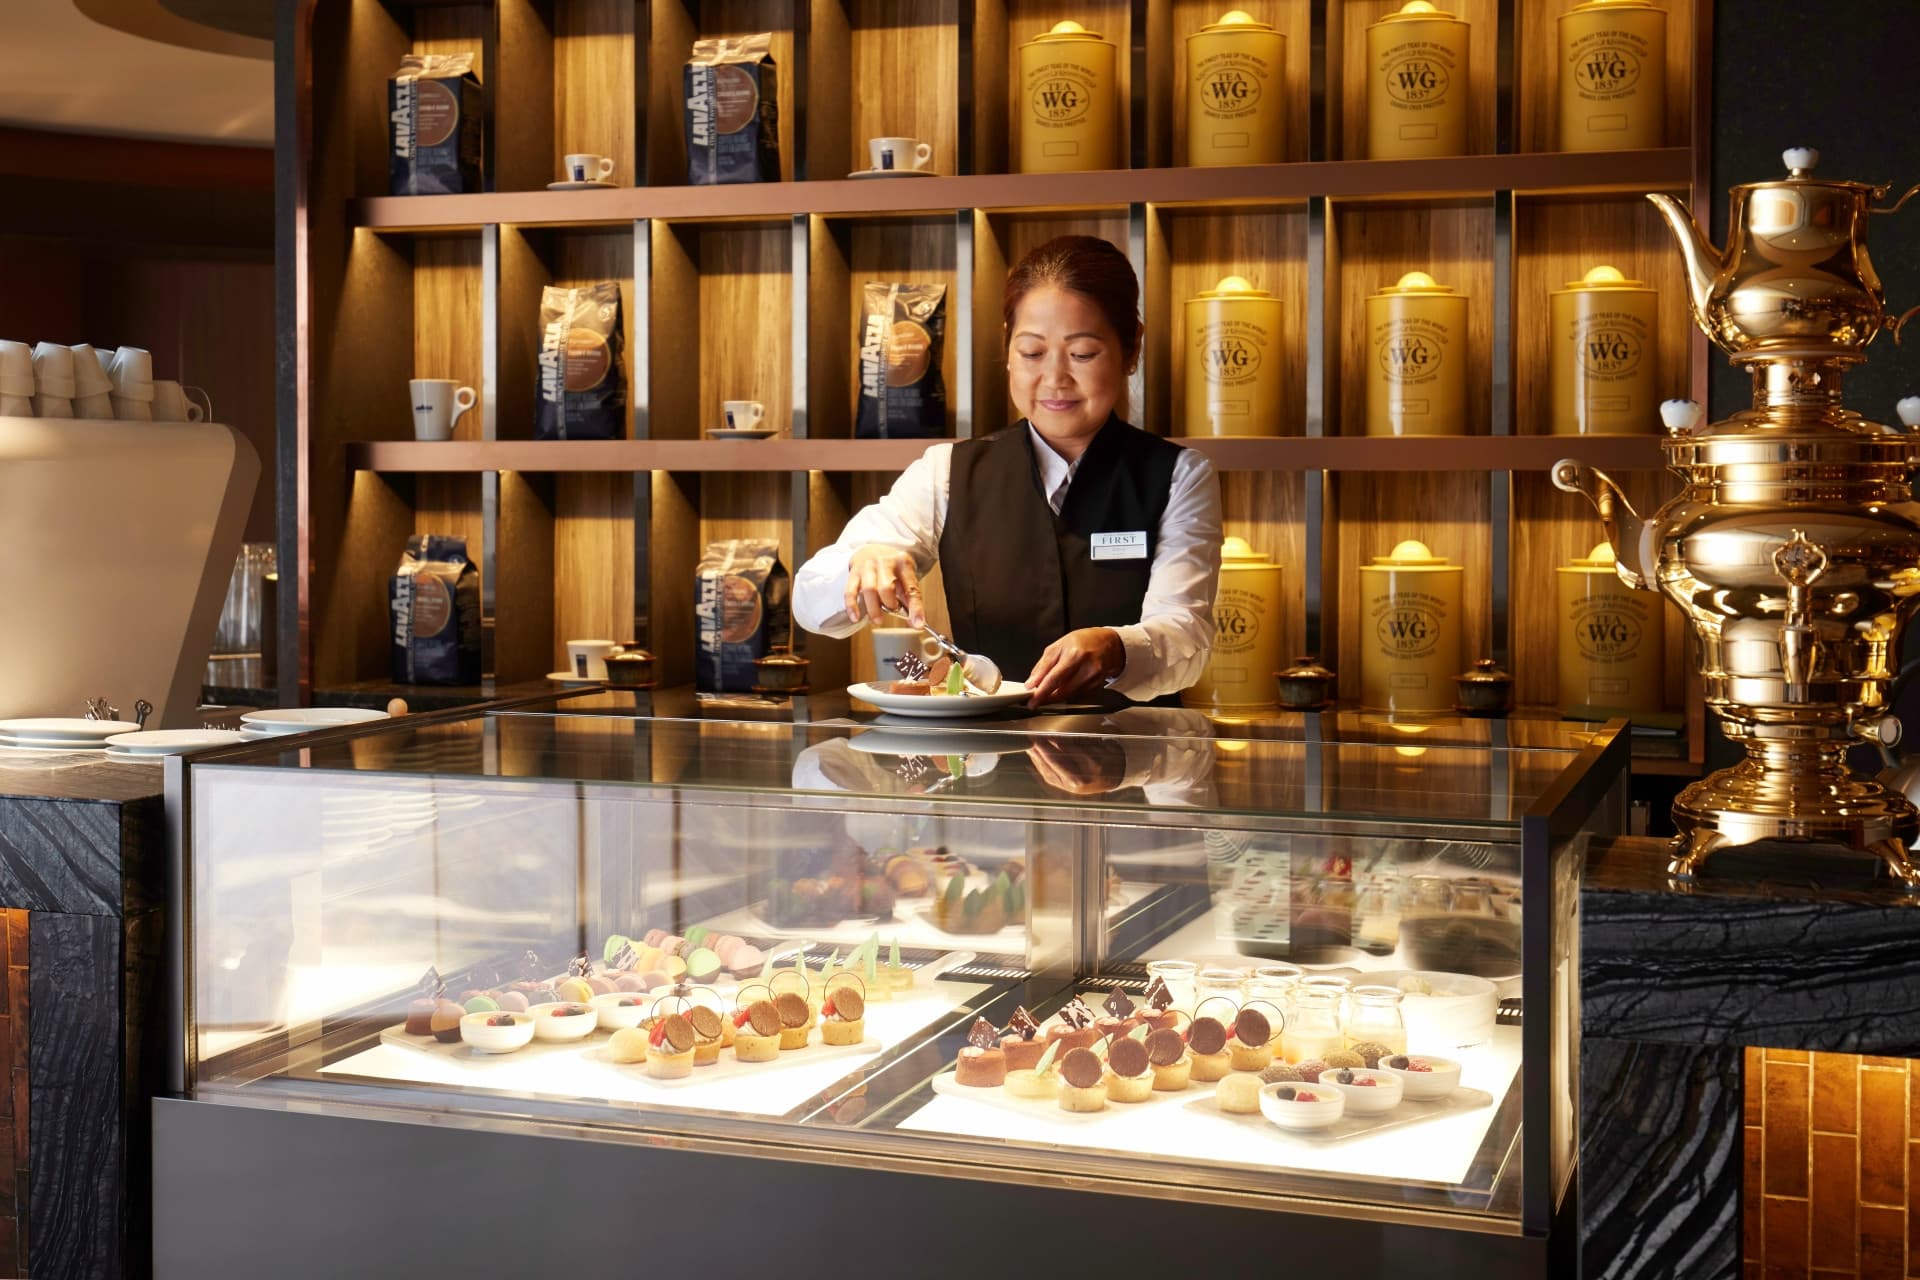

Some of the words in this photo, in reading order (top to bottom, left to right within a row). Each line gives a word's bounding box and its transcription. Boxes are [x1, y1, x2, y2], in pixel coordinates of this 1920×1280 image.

[1594, 51, 1620, 61] TEA
[1405, 63, 1431, 71] TEA
[1585, 61, 1626, 80] WG
[1217, 72, 1243, 81] TEA
[1397, 71, 1436, 90] WG
[1048, 82, 1072, 91] TEA
[1210, 81, 1248, 99] WG
[1042, 91, 1078, 108] WG
[1398, 338, 1423, 347] TEA
[1597, 333, 1623, 342] TEA
[1218, 340, 1243, 349] TEA
[1391, 346, 1428, 365] WG
[1589, 342, 1628, 361] WG
[1211, 349, 1248, 367] WG
[1102, 535, 1137, 544] FIRST
[1217, 608, 1241, 617] TEA
[1395, 612, 1420, 621] TEA
[1387, 621, 1427, 639] WG
[1588, 624, 1628, 642] WG
